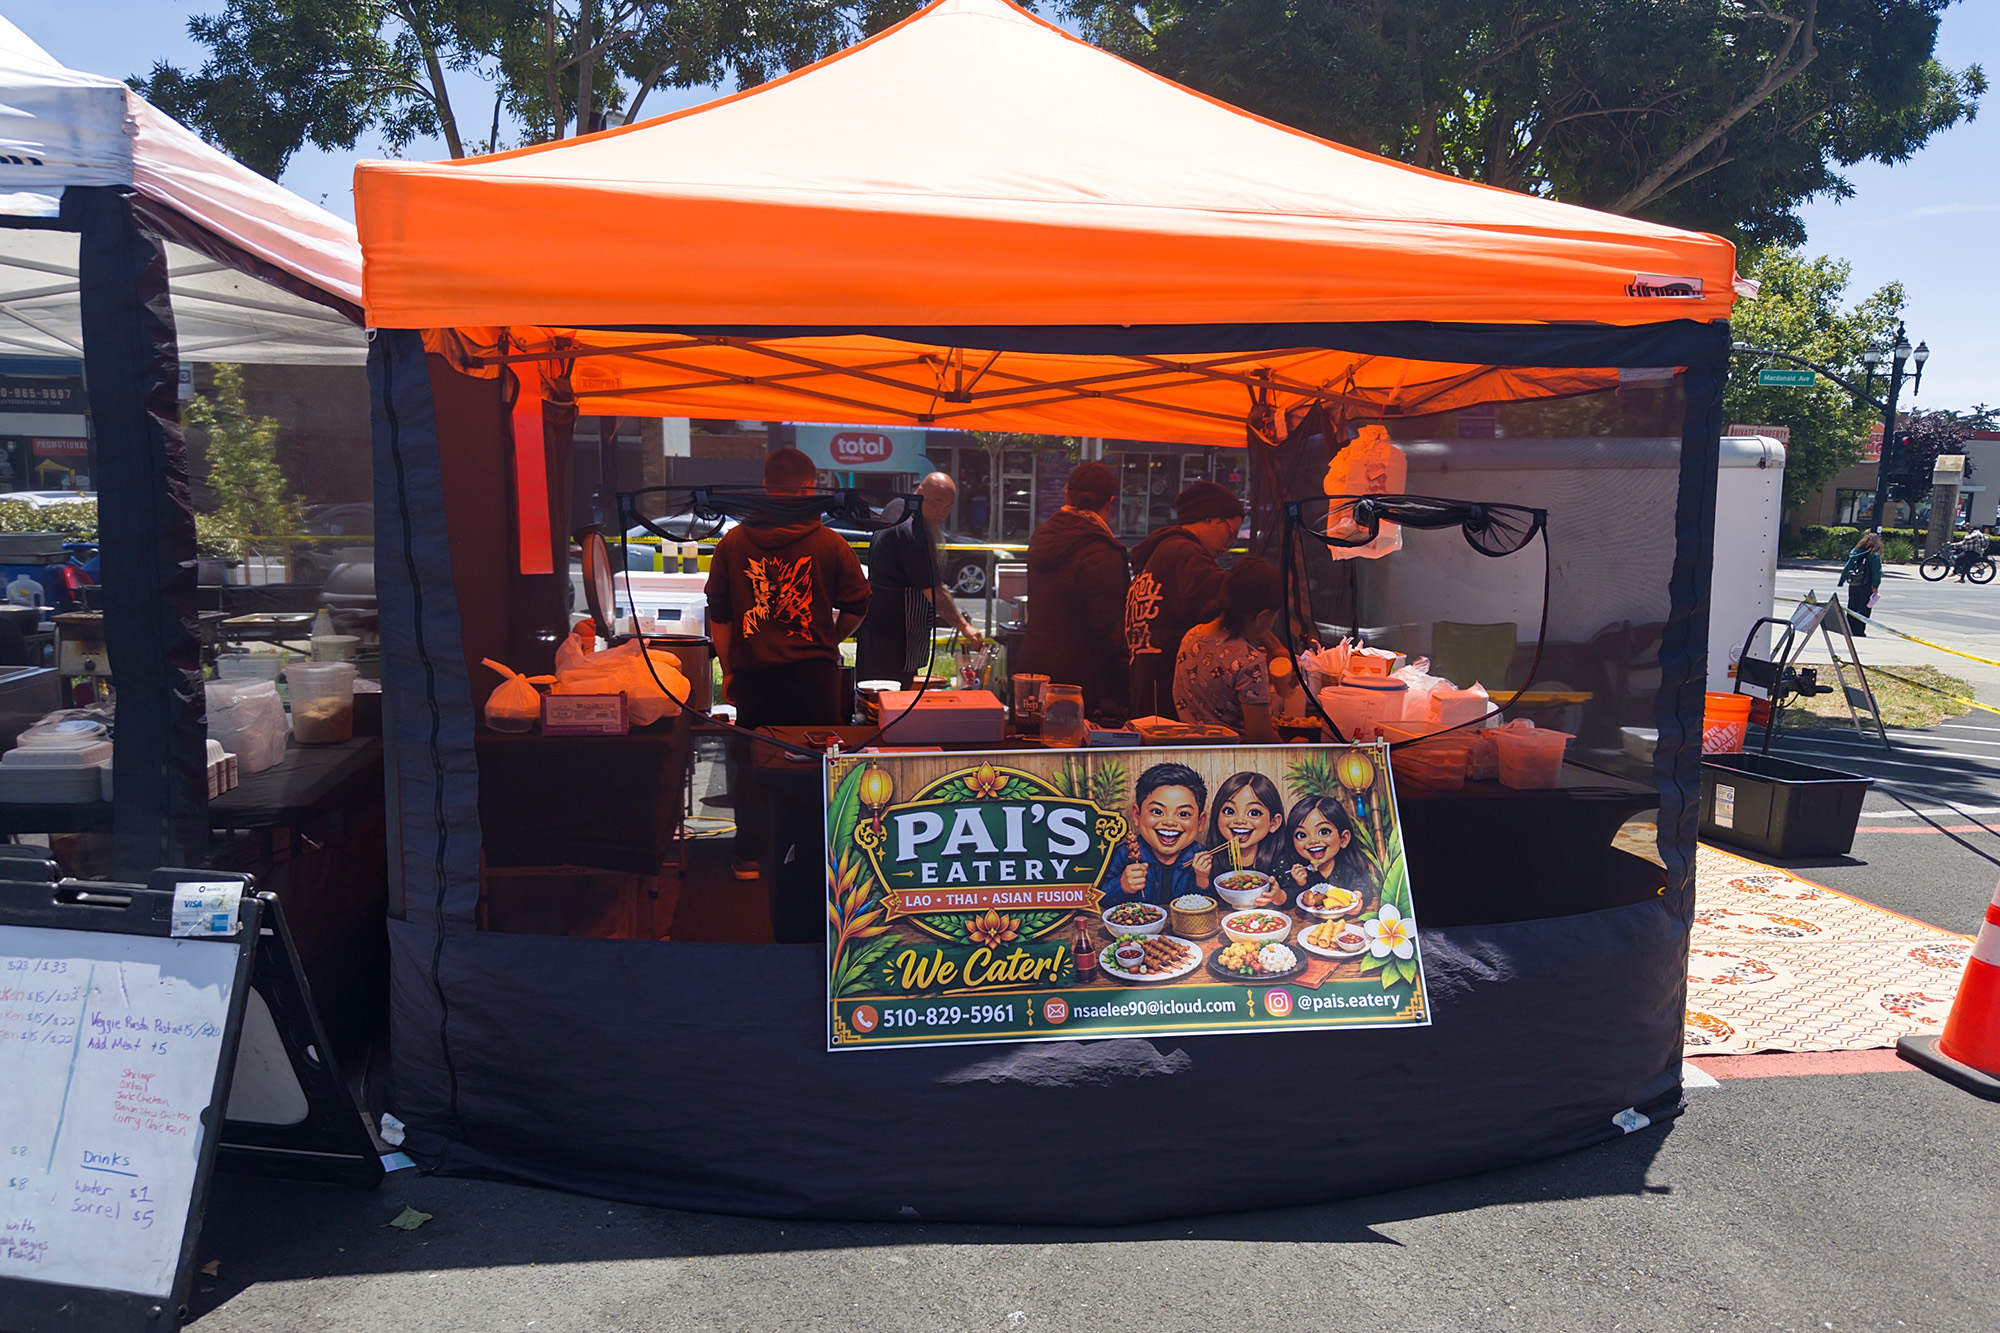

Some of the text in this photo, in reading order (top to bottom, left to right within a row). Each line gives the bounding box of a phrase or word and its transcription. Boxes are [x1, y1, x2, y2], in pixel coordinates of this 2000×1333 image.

[1763, 374, 1796, 382] Macdonald
[1731, 428, 1788, 439] PRIVATE PROPERTY
[36, 441, 88, 450] PROMOTIONAL
[838, 437, 884, 455] total
[1702, 724, 1722, 739] THE
[893, 803, 1091, 863] PAI'S
[920, 859, 1071, 884] EATERY
[183, 900, 203, 909] VISA
[905, 889, 1084, 908] LAO THAI ASIAN FUSION
[896, 945, 1067, 990] We Cater!
[882, 991, 1401, 1028] 510-829-5961 nsaelee90@icloud.com @pais.eatery
[91, 1011, 122, 1035] Veggie
[87, 1036, 107, 1051] Add
[111, 1037, 141, 1051] Meat
[121, 1068, 156, 1083] Shrimp
[119, 1080, 148, 1093] Oxtail
[113, 1112, 187, 1136] Curry Chicken
[82, 1150, 131, 1167] Drinks
[8, 1177, 29, 1191] $8
[74, 1179, 115, 1197] Water
[70, 1197, 155, 1230] Sorrel $5
[6, 1218, 36, 1233] with
